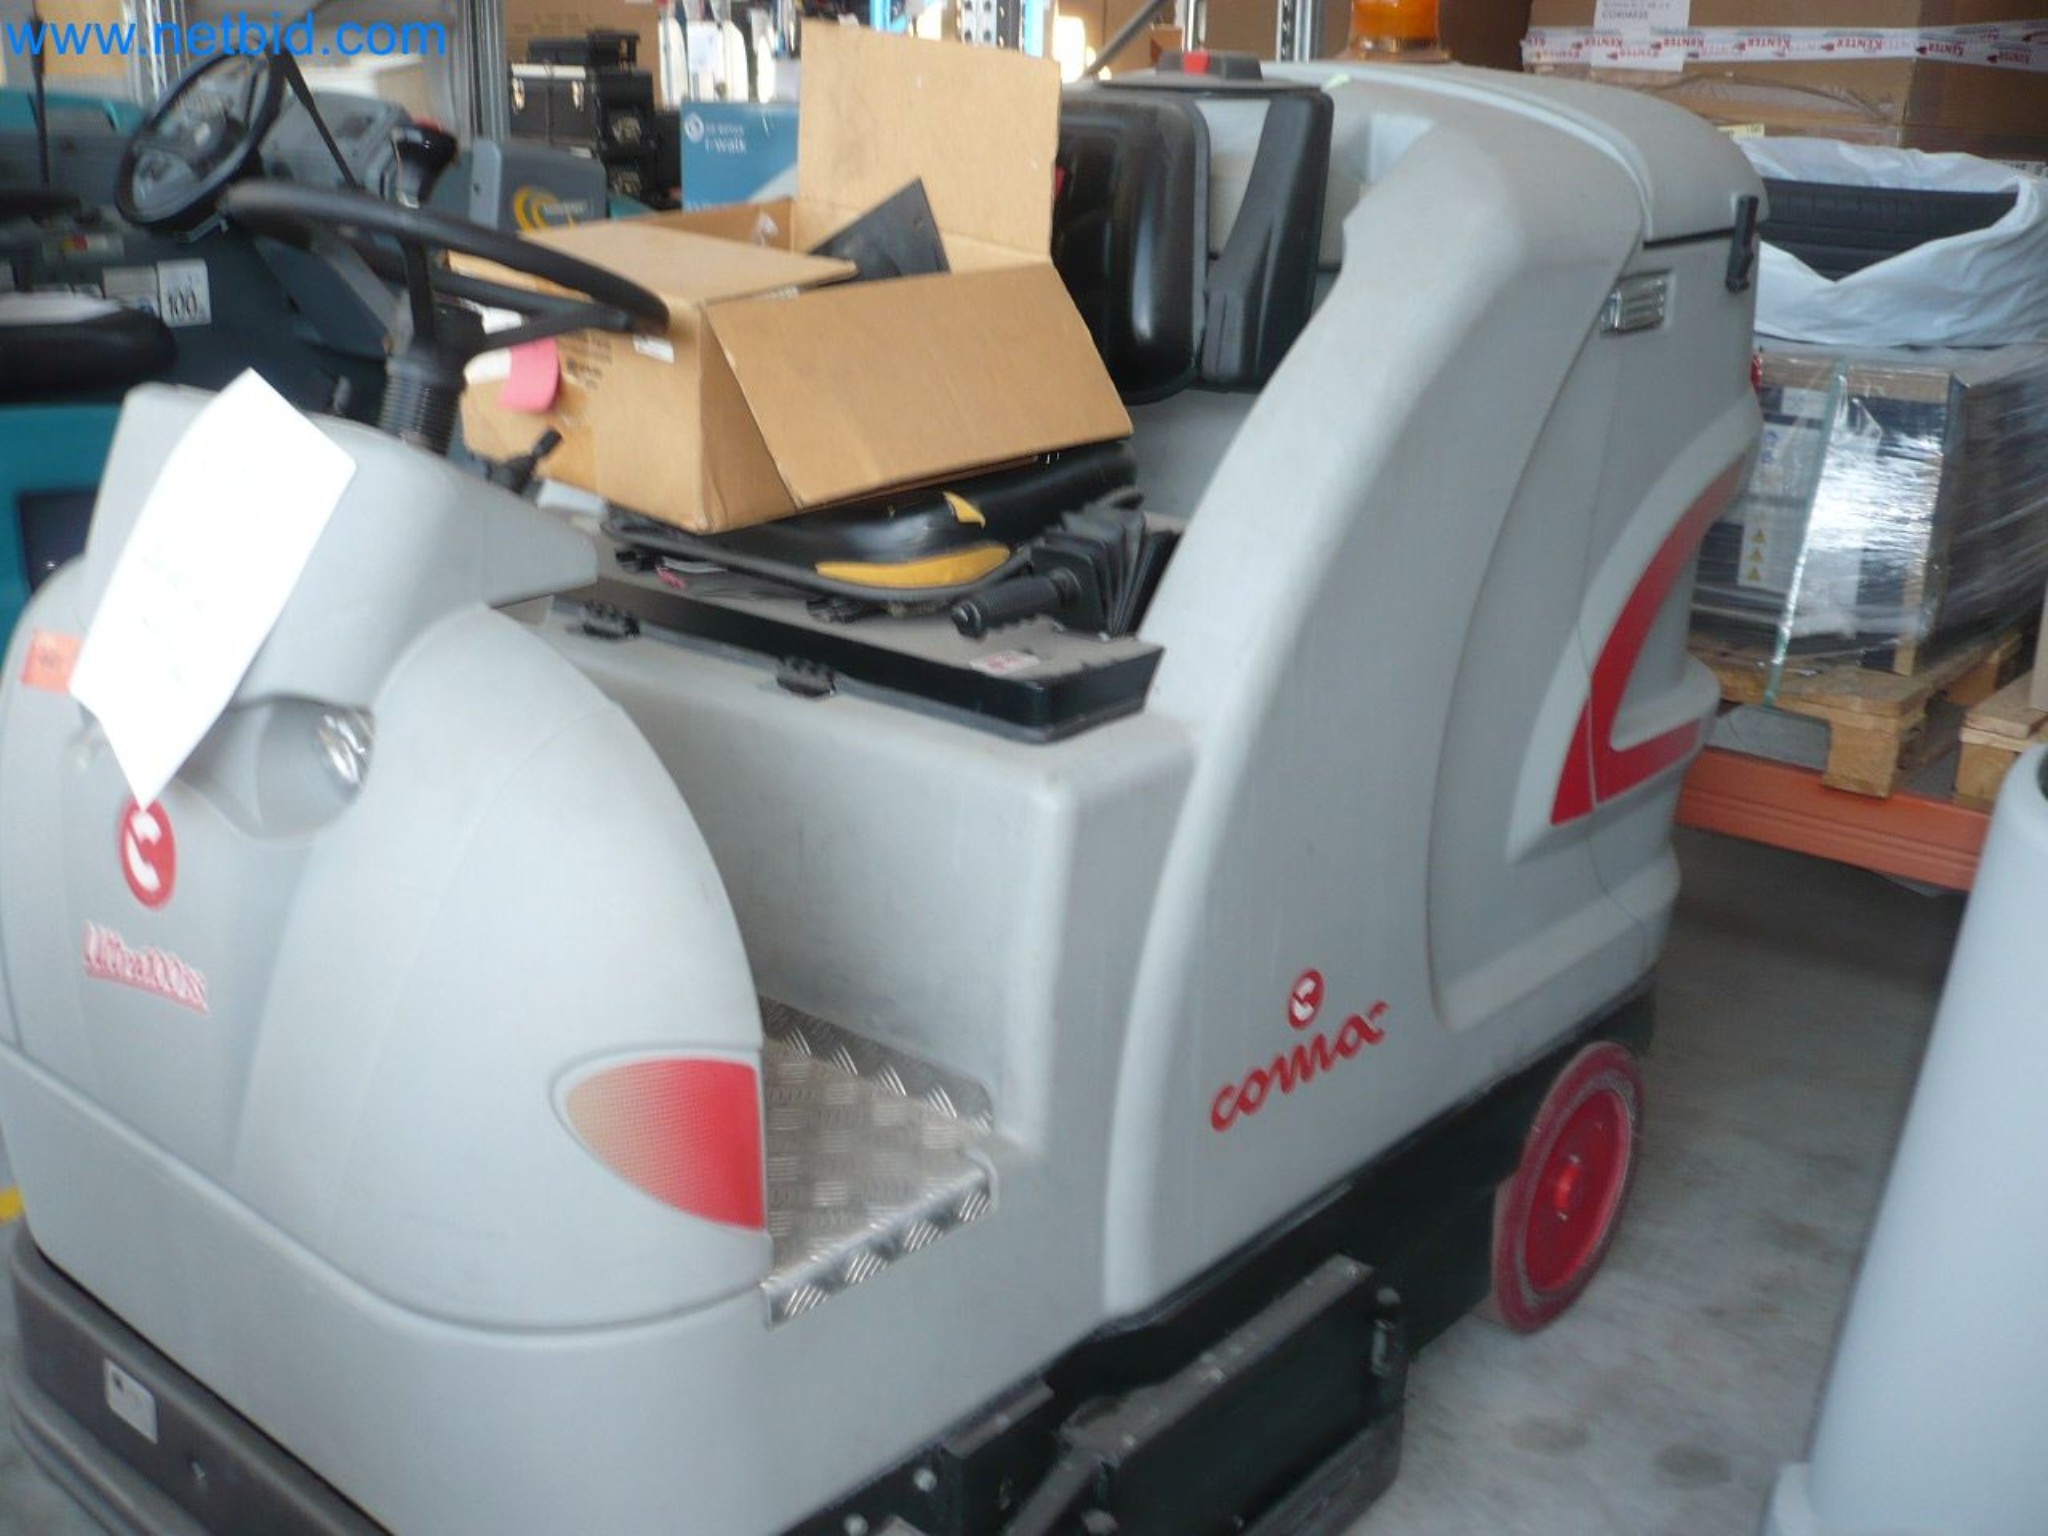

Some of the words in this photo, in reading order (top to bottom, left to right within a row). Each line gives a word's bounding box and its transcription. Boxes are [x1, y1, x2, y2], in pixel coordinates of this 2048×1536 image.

[1663, 37, 1705, 50] KENTER
[1747, 37, 1791, 51] KENTER
[1837, 38, 1883, 51] KENTER
